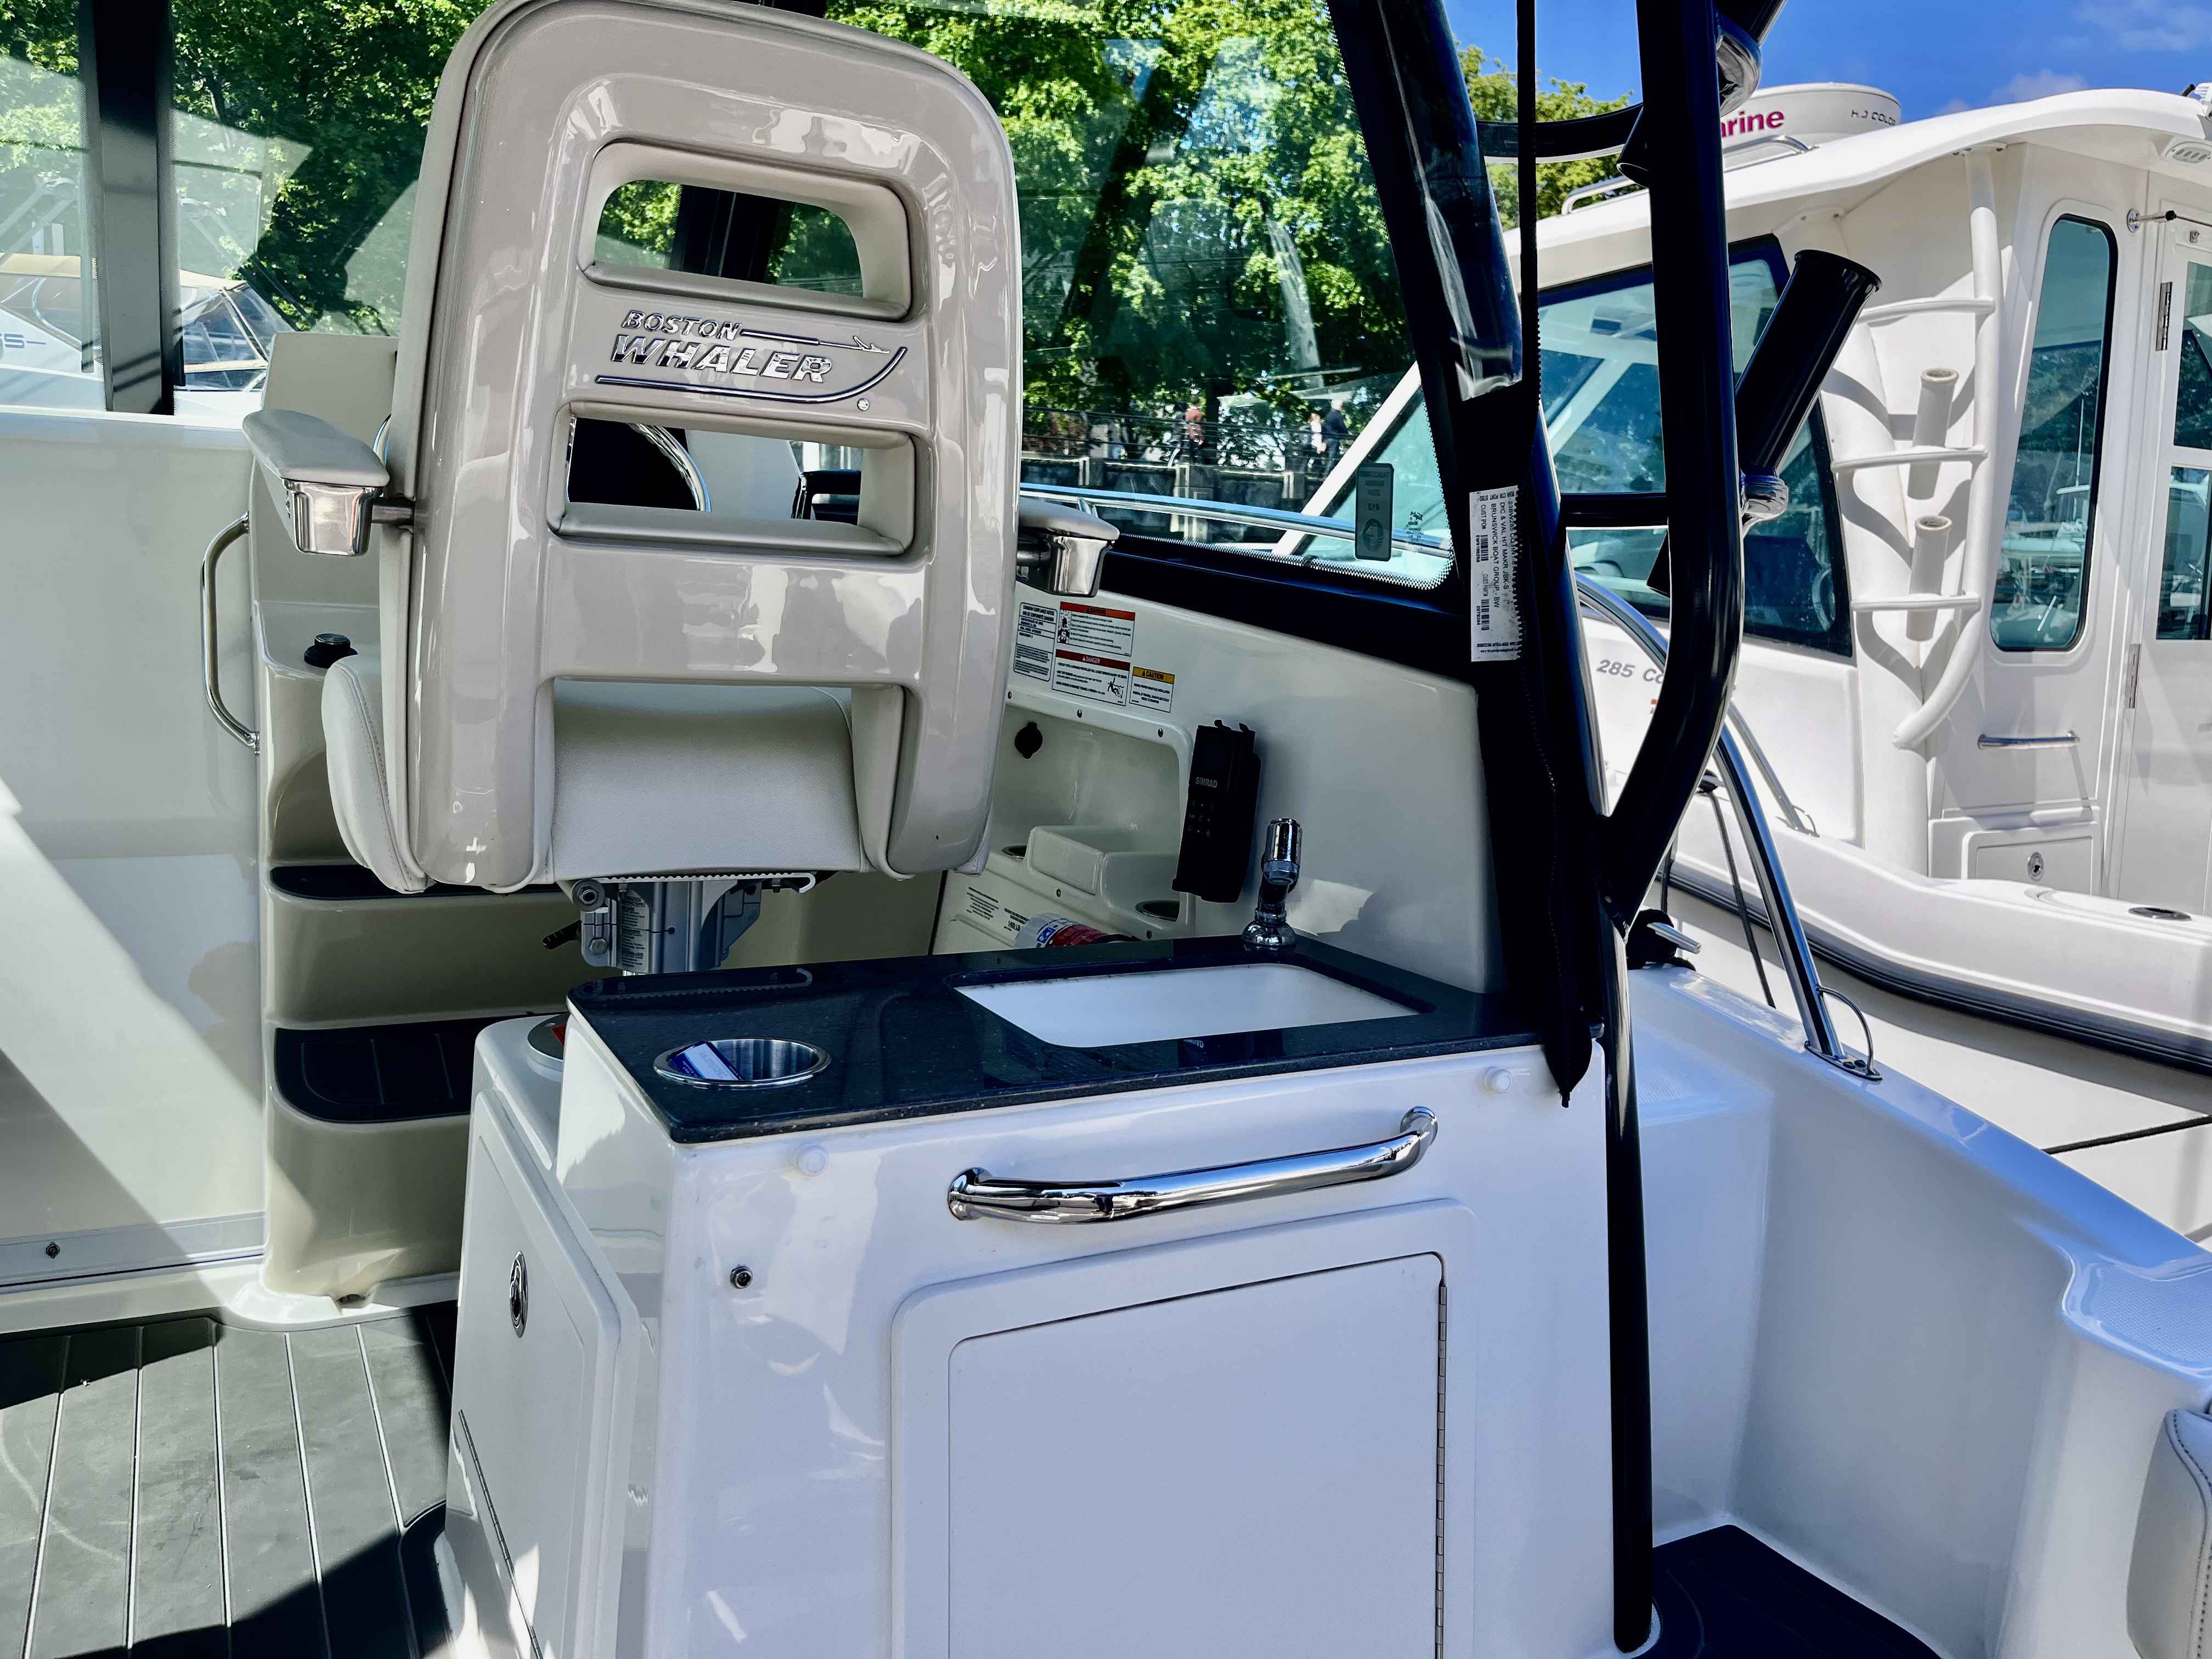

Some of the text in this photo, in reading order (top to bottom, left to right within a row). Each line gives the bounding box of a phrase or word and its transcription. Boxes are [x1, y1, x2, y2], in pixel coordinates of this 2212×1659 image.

[622, 309, 742, 341] BOSTON
[610, 333, 833, 383] WHALER
[1494, 597, 1500, 608] BW
[1146, 670, 1164, 680] CAUTION
[1596, 659, 1635, 678] 285
[1195, 776, 1217, 788] SIMRAD
